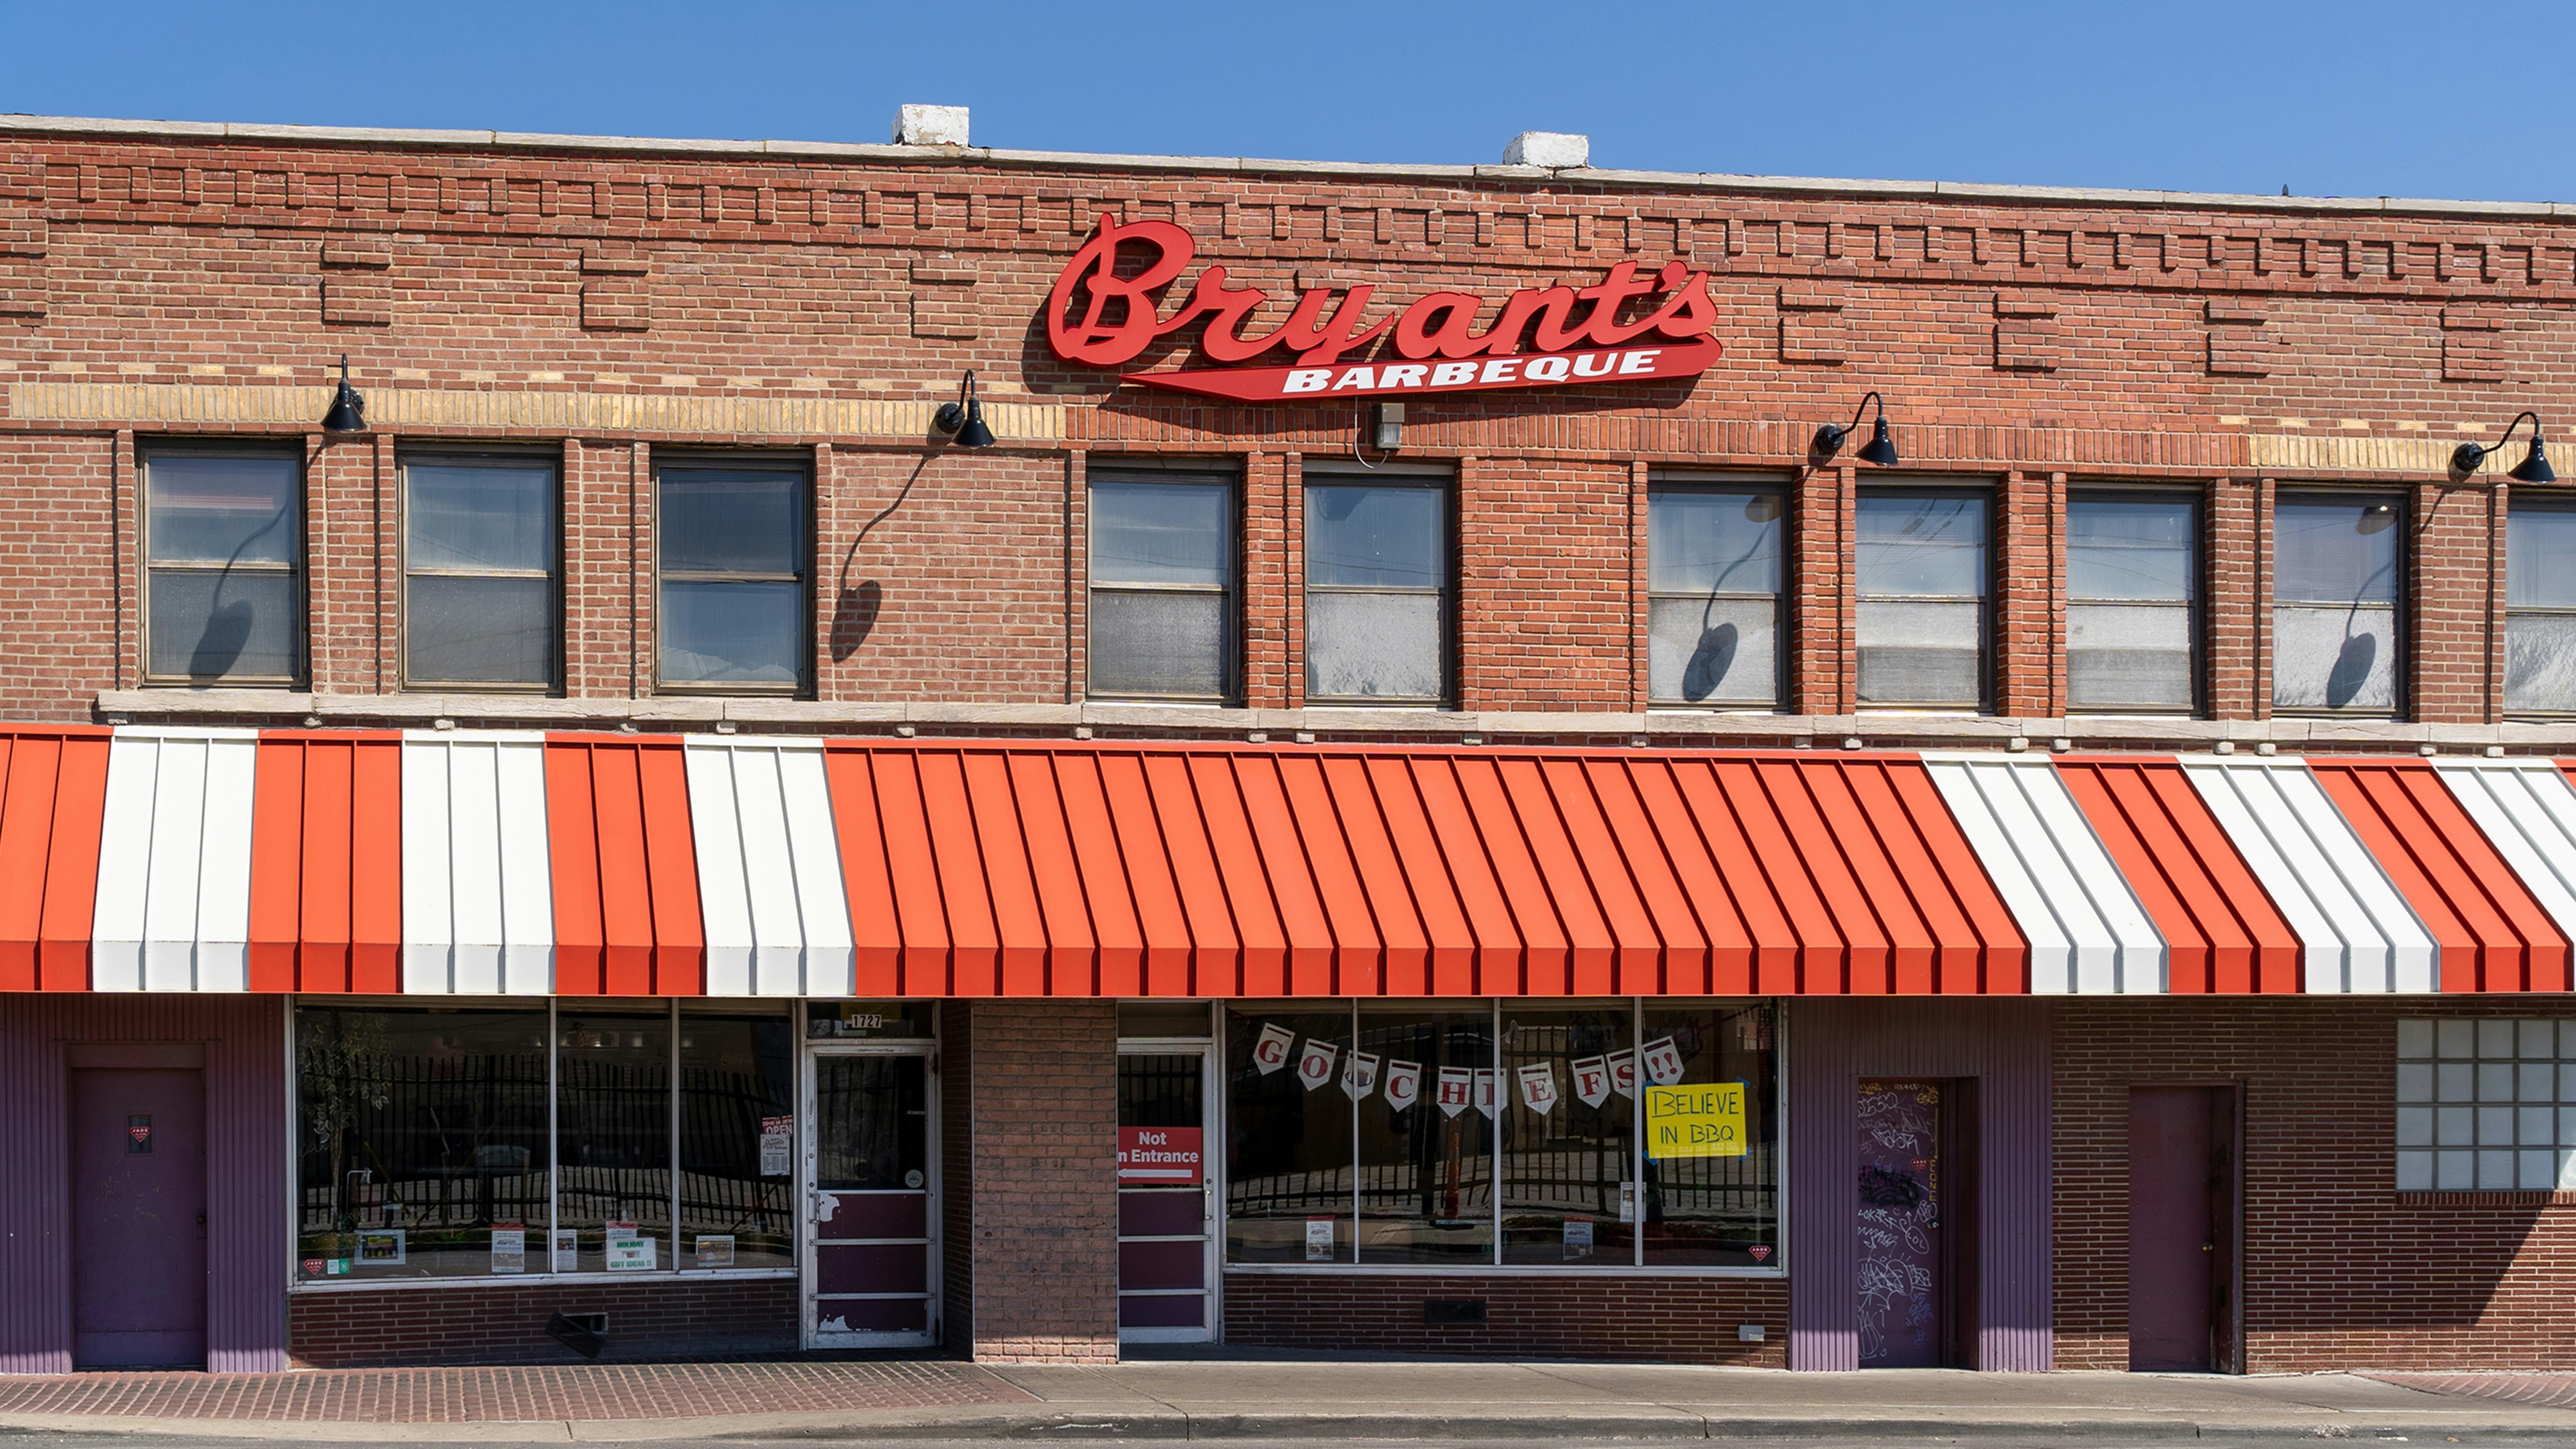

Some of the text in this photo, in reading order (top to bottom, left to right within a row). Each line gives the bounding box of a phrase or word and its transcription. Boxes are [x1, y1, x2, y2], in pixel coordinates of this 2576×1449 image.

[1047, 212, 1718, 367] Bryant's
[1283, 350, 1661, 393] BARBEQUE
[854, 1015, 880, 1027] 1727
[1652, 1091, 1739, 1118] BELIEVE
[766, 1124, 793, 1135] OPEN
[1139, 1131, 1167, 1145] Not
[1660, 1124, 1734, 1144] IN BBQ
[1131, 1149, 1199, 1163] Entrance
